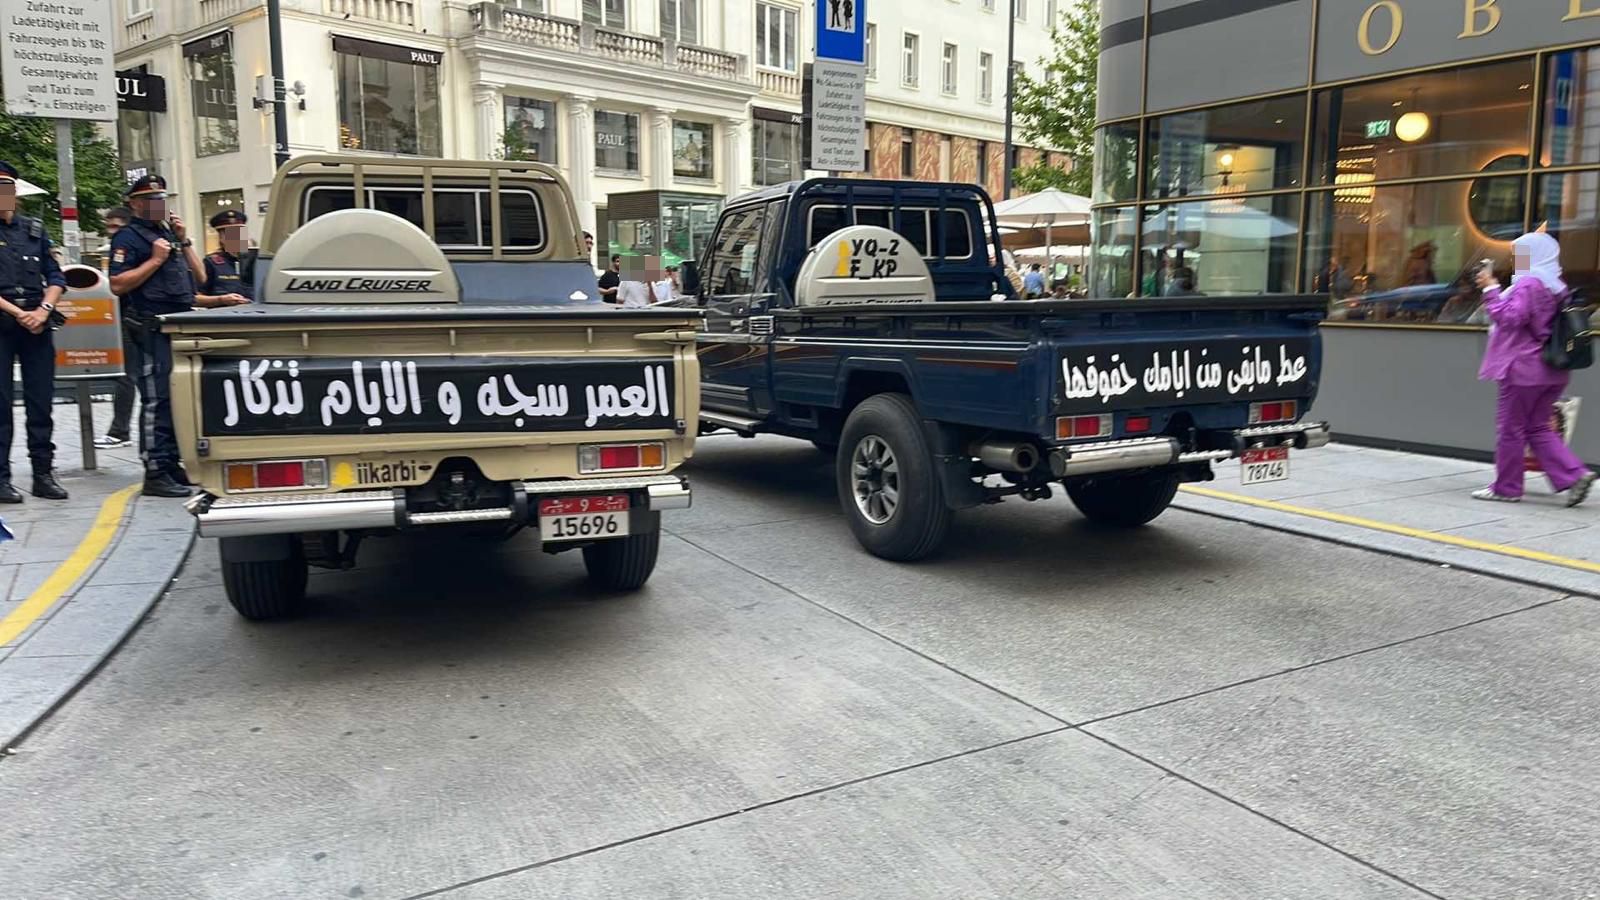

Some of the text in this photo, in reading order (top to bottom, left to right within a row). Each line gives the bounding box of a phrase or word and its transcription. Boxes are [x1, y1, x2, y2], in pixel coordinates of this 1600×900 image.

[27, 1, 84, 15] Zufahrt zur
[12, 16, 100, 32] Ladetätigkeit mit
[8, 32, 69, 48] Fahrzeugen
[72, 37, 87, 48] bis
[14, 49, 104, 66] höchstzulässigem
[410, 51, 438, 64] PAUL
[21, 66, 98, 80] Gesamtgewicht
[27, 84, 95, 96] und Taxi zum
[53, 99, 106, 113] Einsteigen
[598, 133, 625, 146] PAUL
[285, 277, 432, 291] LAND CRUISER
[1196, 348, 1222, 389] من
[438, 381, 462, 425] و
[585, 365, 669, 428] العمر
[1248, 462, 1284, 481] 78746
[580, 499, 590, 512] 9
[552, 514, 618, 538] 15696
